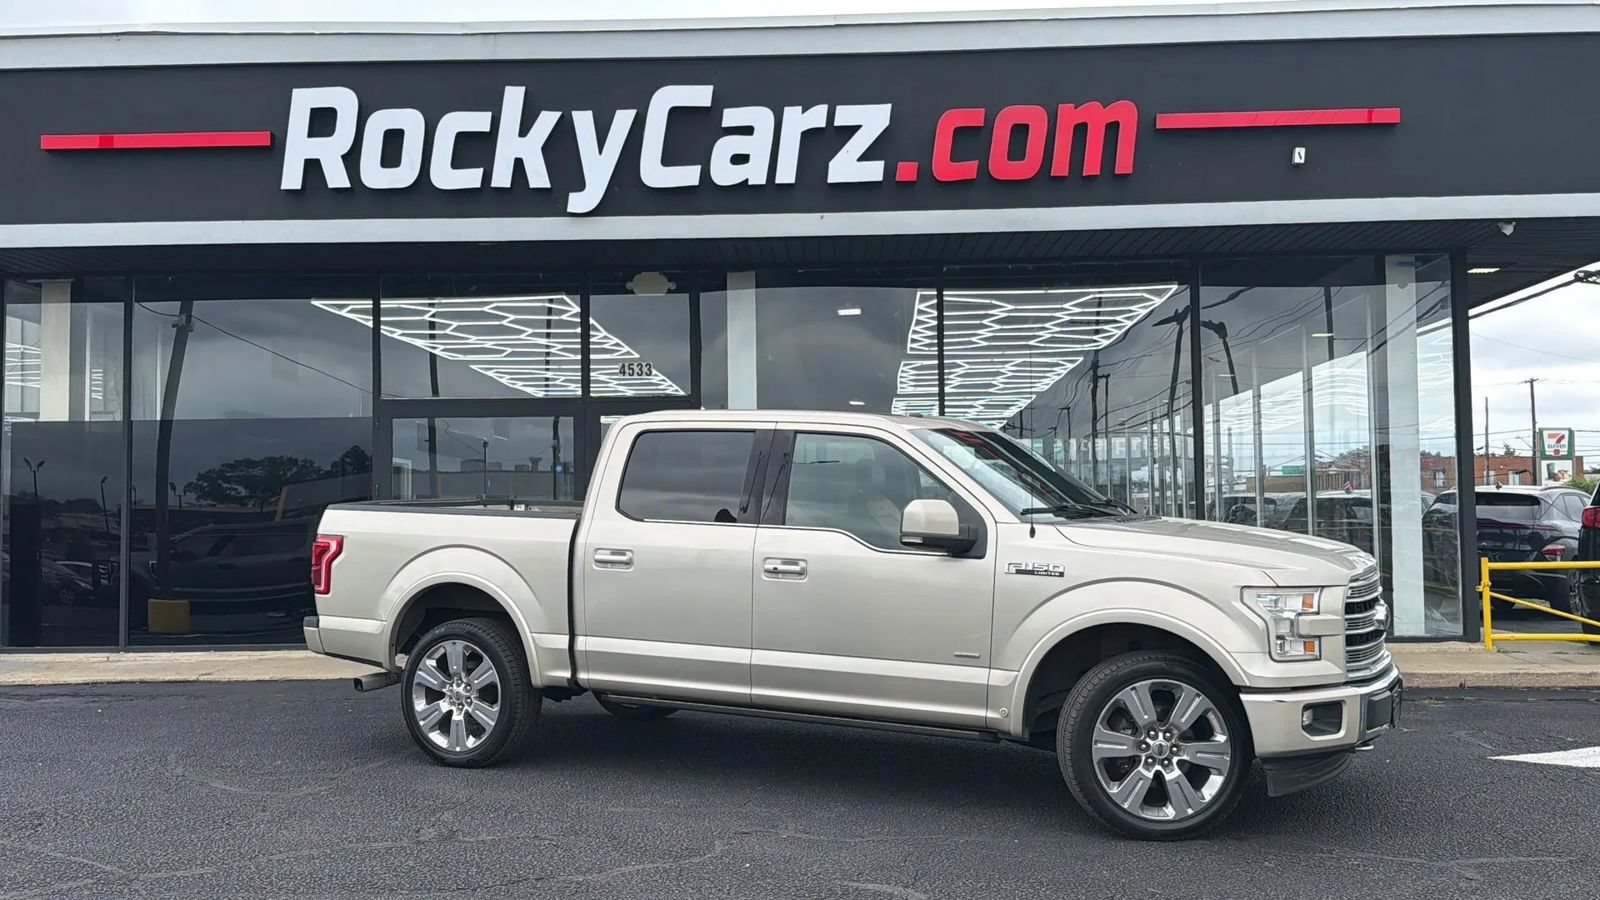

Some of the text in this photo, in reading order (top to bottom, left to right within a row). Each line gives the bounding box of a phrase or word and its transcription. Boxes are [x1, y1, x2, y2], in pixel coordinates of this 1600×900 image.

[280, 84, 1139, 215] RockyCarz.com
[618, 362, 653, 377] 4533
[1547, 432, 1566, 455] 7
